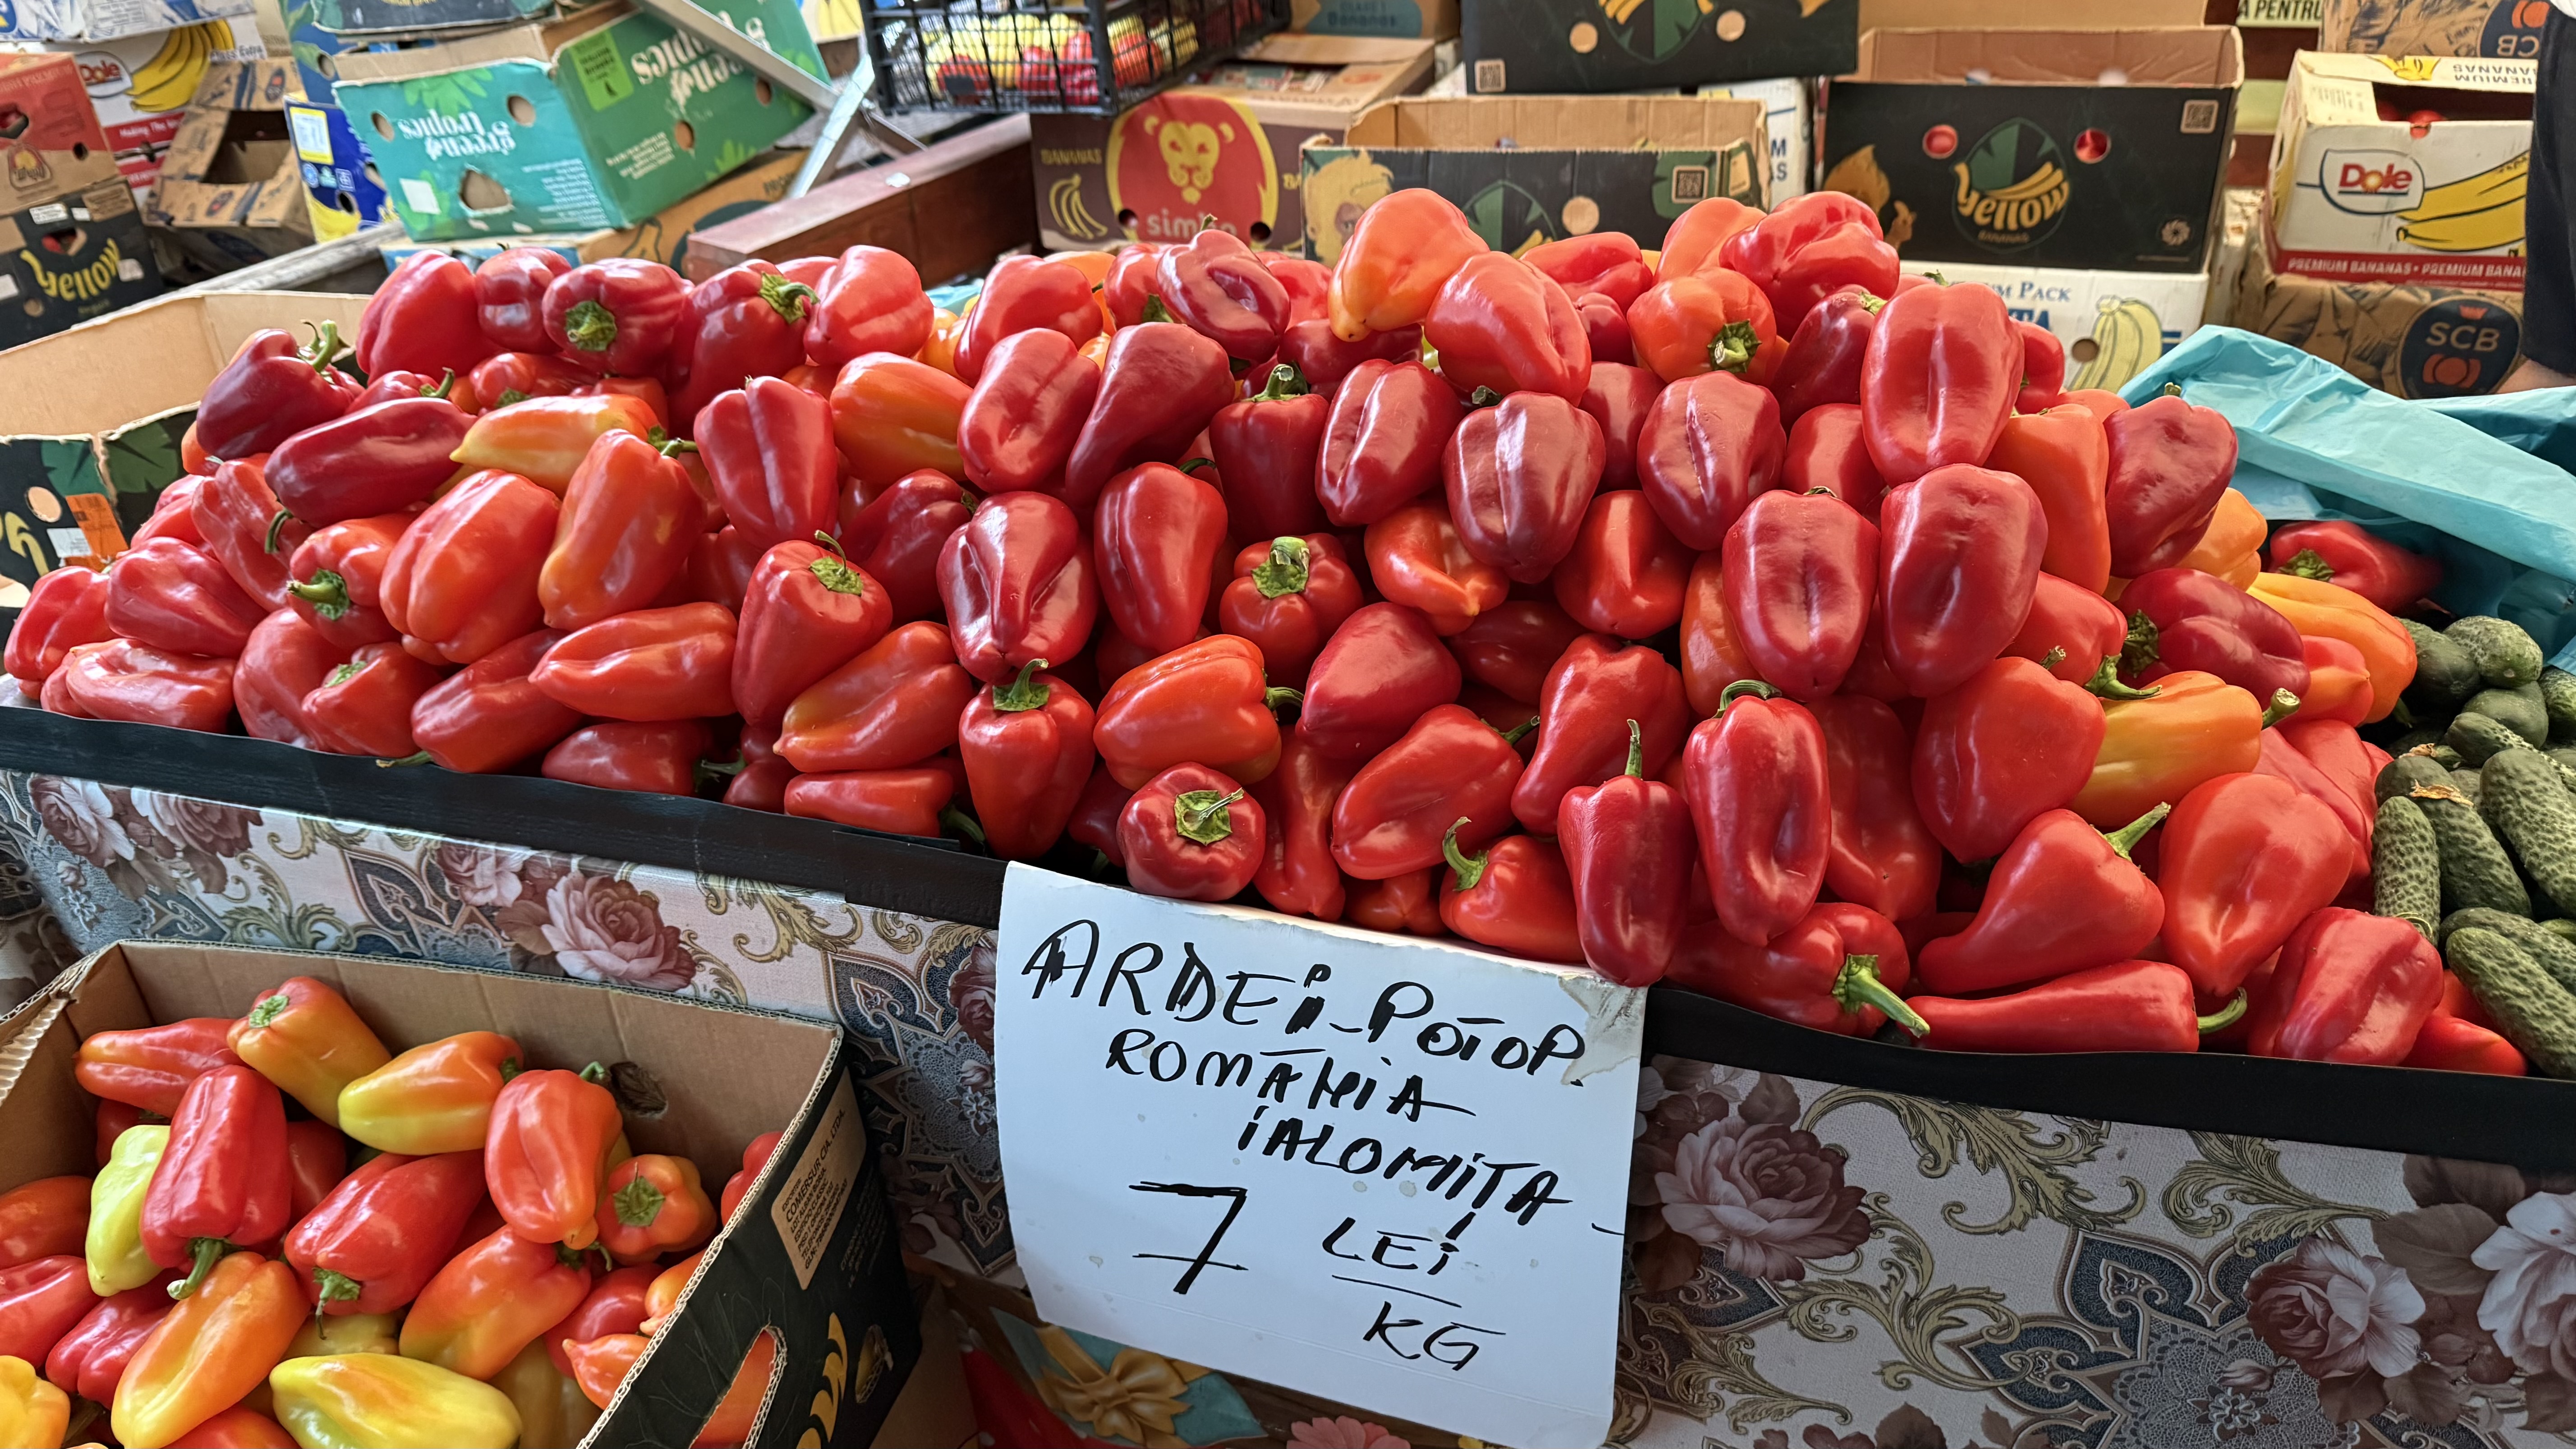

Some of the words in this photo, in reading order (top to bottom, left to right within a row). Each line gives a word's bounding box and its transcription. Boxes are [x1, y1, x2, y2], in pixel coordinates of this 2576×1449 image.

[397, 108, 486, 139] tropics
[441, 121, 516, 156] green
[1040, 148, 1102, 166] BANANAS
[2338, 163, 2413, 192] Dole
[1954, 161, 2069, 231] yellow
[2288, 257, 2348, 272] PREMIUM
[2350, 260, 2411, 275] BANANAS
[2421, 262, 2484, 276] PREMIUM
[2425, 321, 2501, 352] SCB
[786, 1158, 821, 1224] COMERSUR
[1129, 1181, 1248, 1294] 7
[1363, 1302, 1506, 1371] KG
